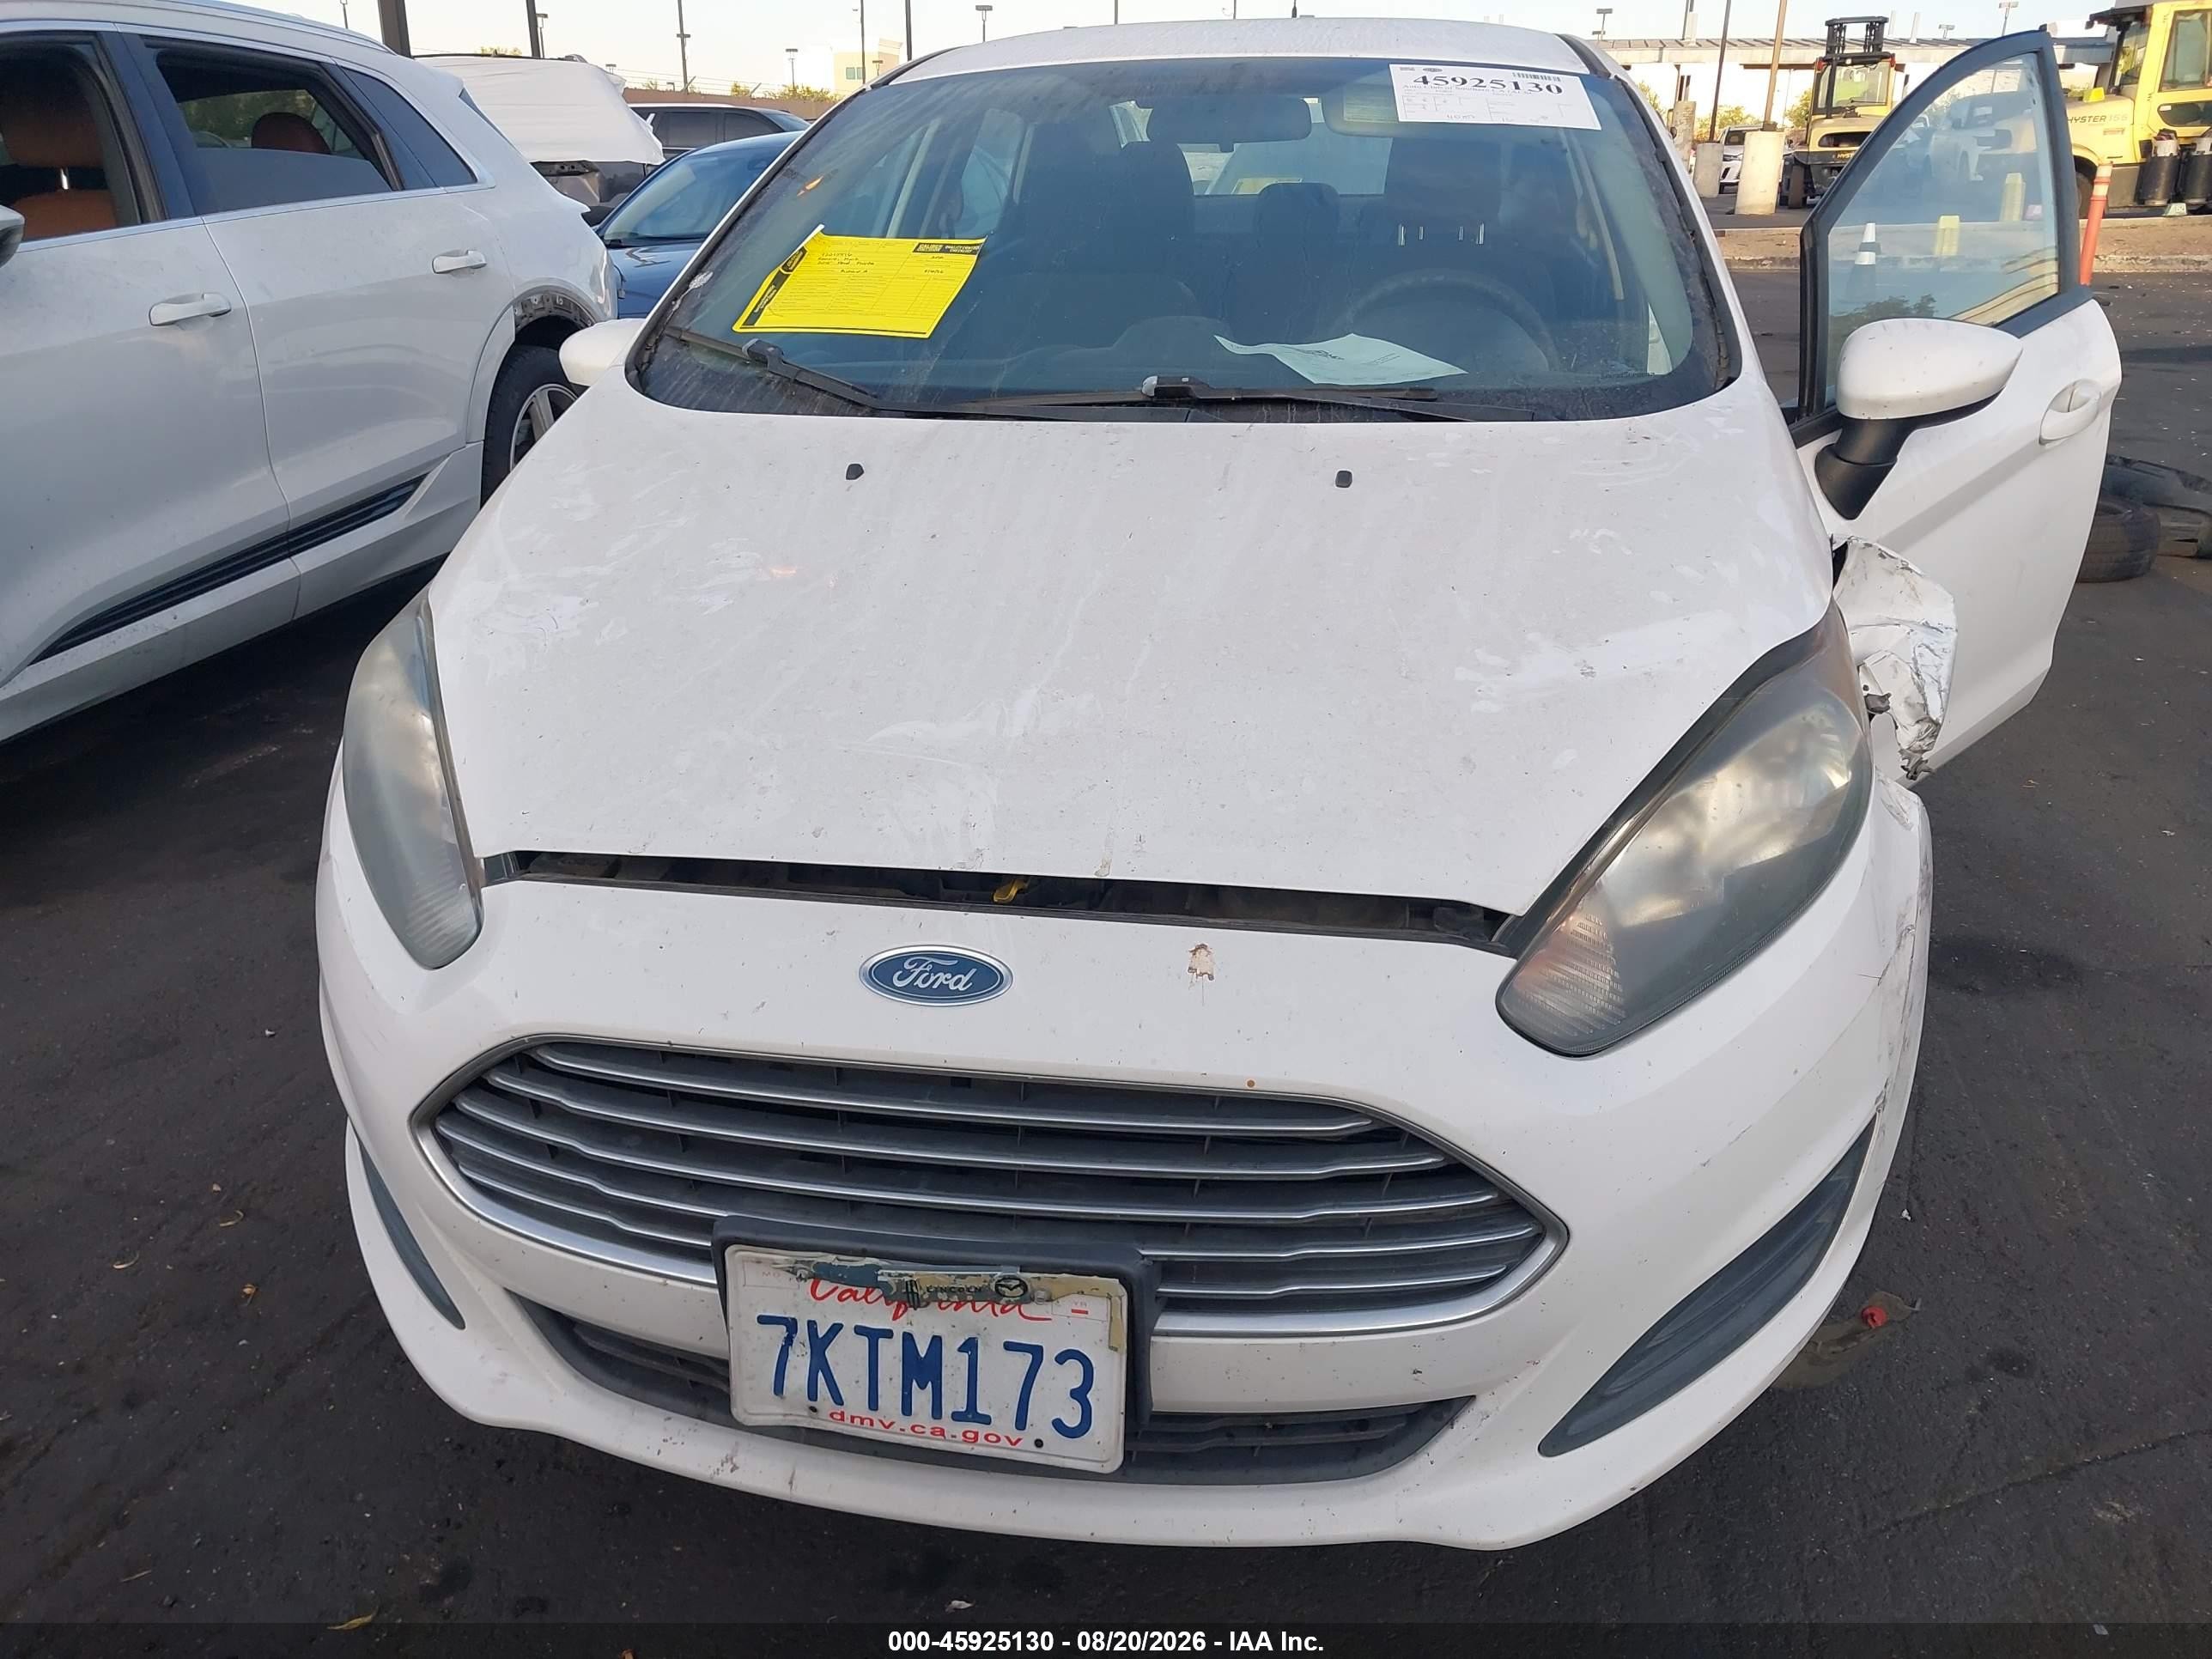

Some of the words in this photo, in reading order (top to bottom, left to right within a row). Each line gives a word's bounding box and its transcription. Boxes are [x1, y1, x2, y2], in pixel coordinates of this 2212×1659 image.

[1413, 75, 1563, 94] 45925130
[892, 956, 977, 992] Ford
[757, 1314, 1095, 1440] 7KTM173
[829, 1410, 1024, 1448] dmv.ca.gov
